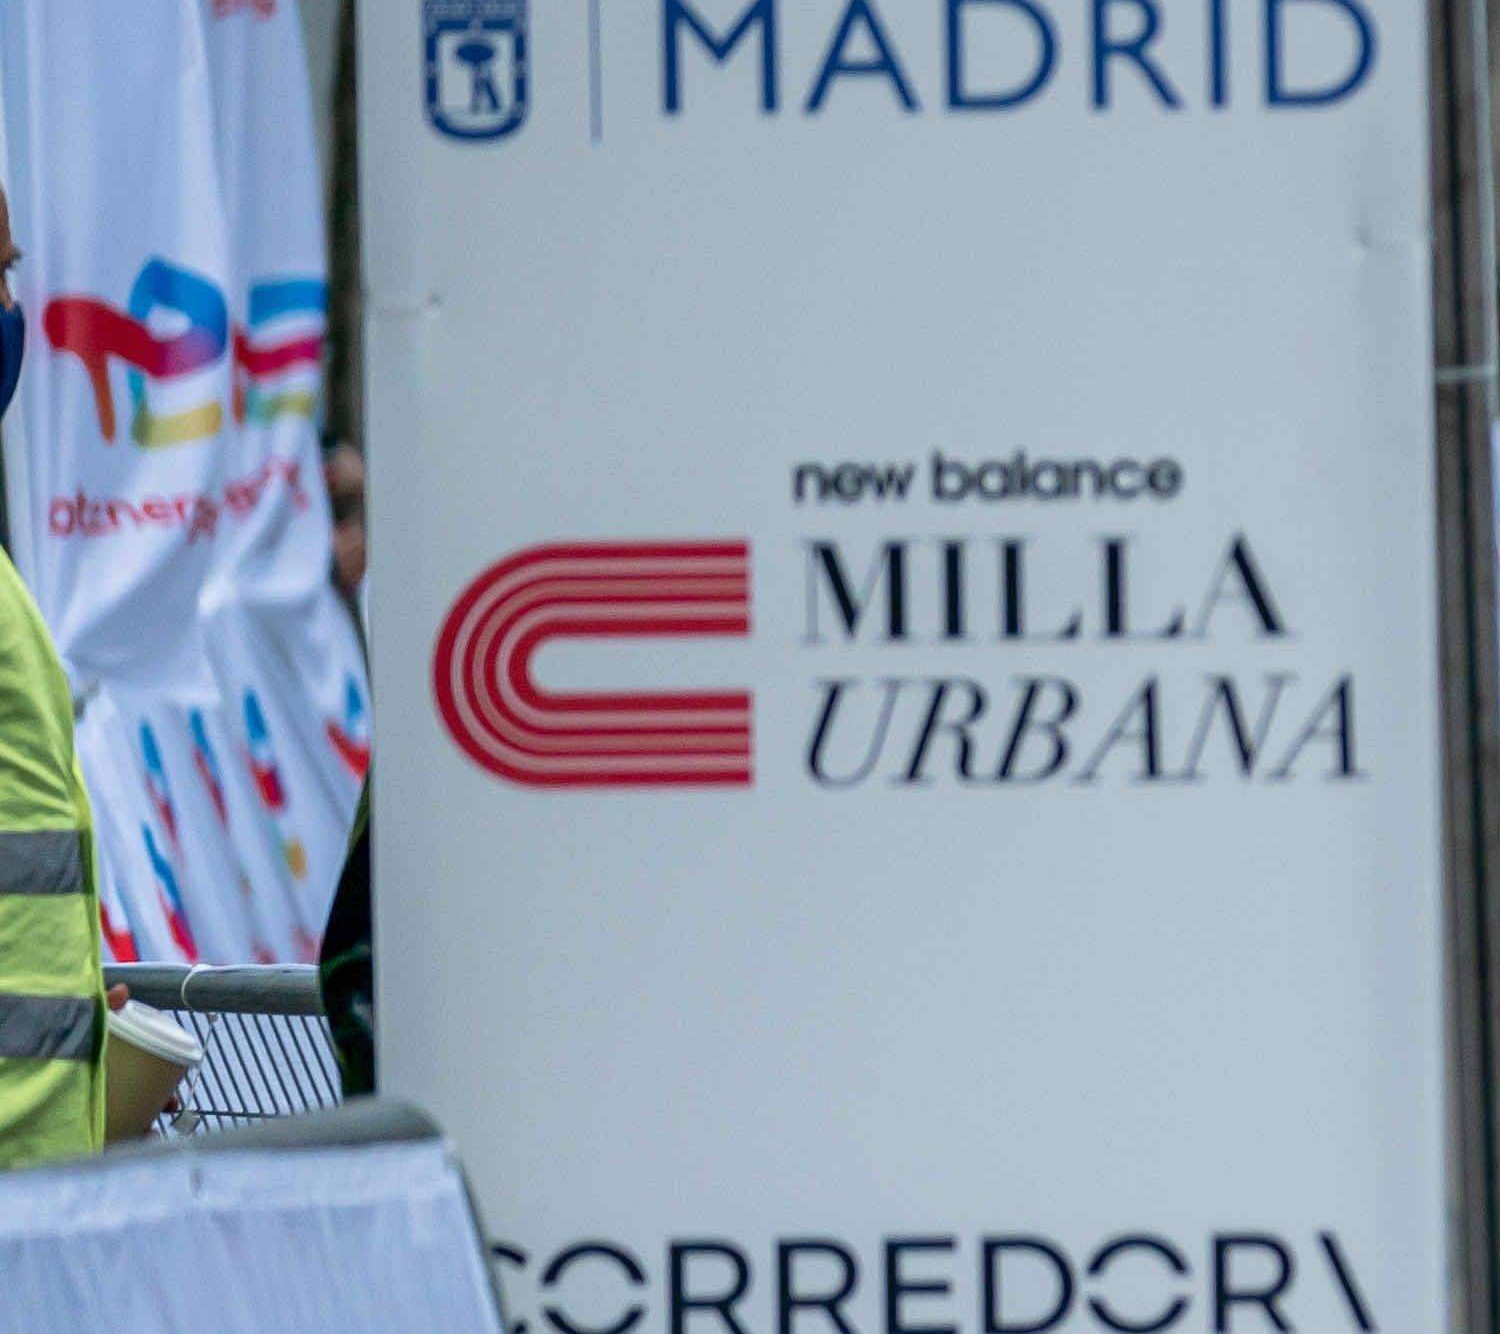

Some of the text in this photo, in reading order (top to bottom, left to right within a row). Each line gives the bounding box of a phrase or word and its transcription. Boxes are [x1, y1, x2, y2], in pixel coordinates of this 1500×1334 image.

[793, 453, 1184, 505] new balance
[800, 531, 1296, 647] MILLA
[803, 672, 1370, 789] URBANA
